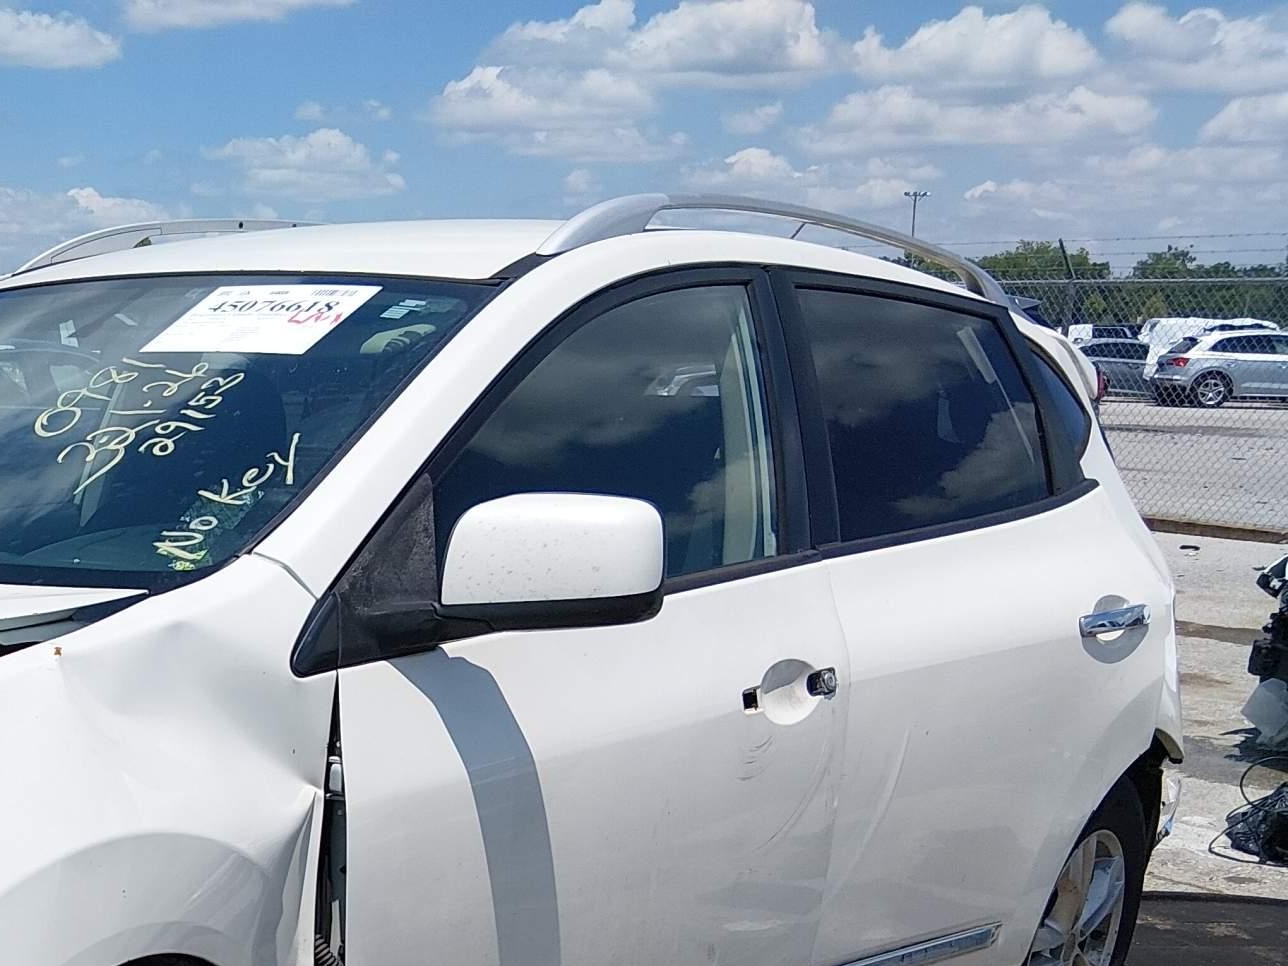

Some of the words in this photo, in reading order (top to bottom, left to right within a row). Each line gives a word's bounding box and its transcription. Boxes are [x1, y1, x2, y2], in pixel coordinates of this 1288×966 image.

[208, 299, 341, 313] 45076618
[34, 357, 167, 438] 0981
[152, 515, 219, 561] No
